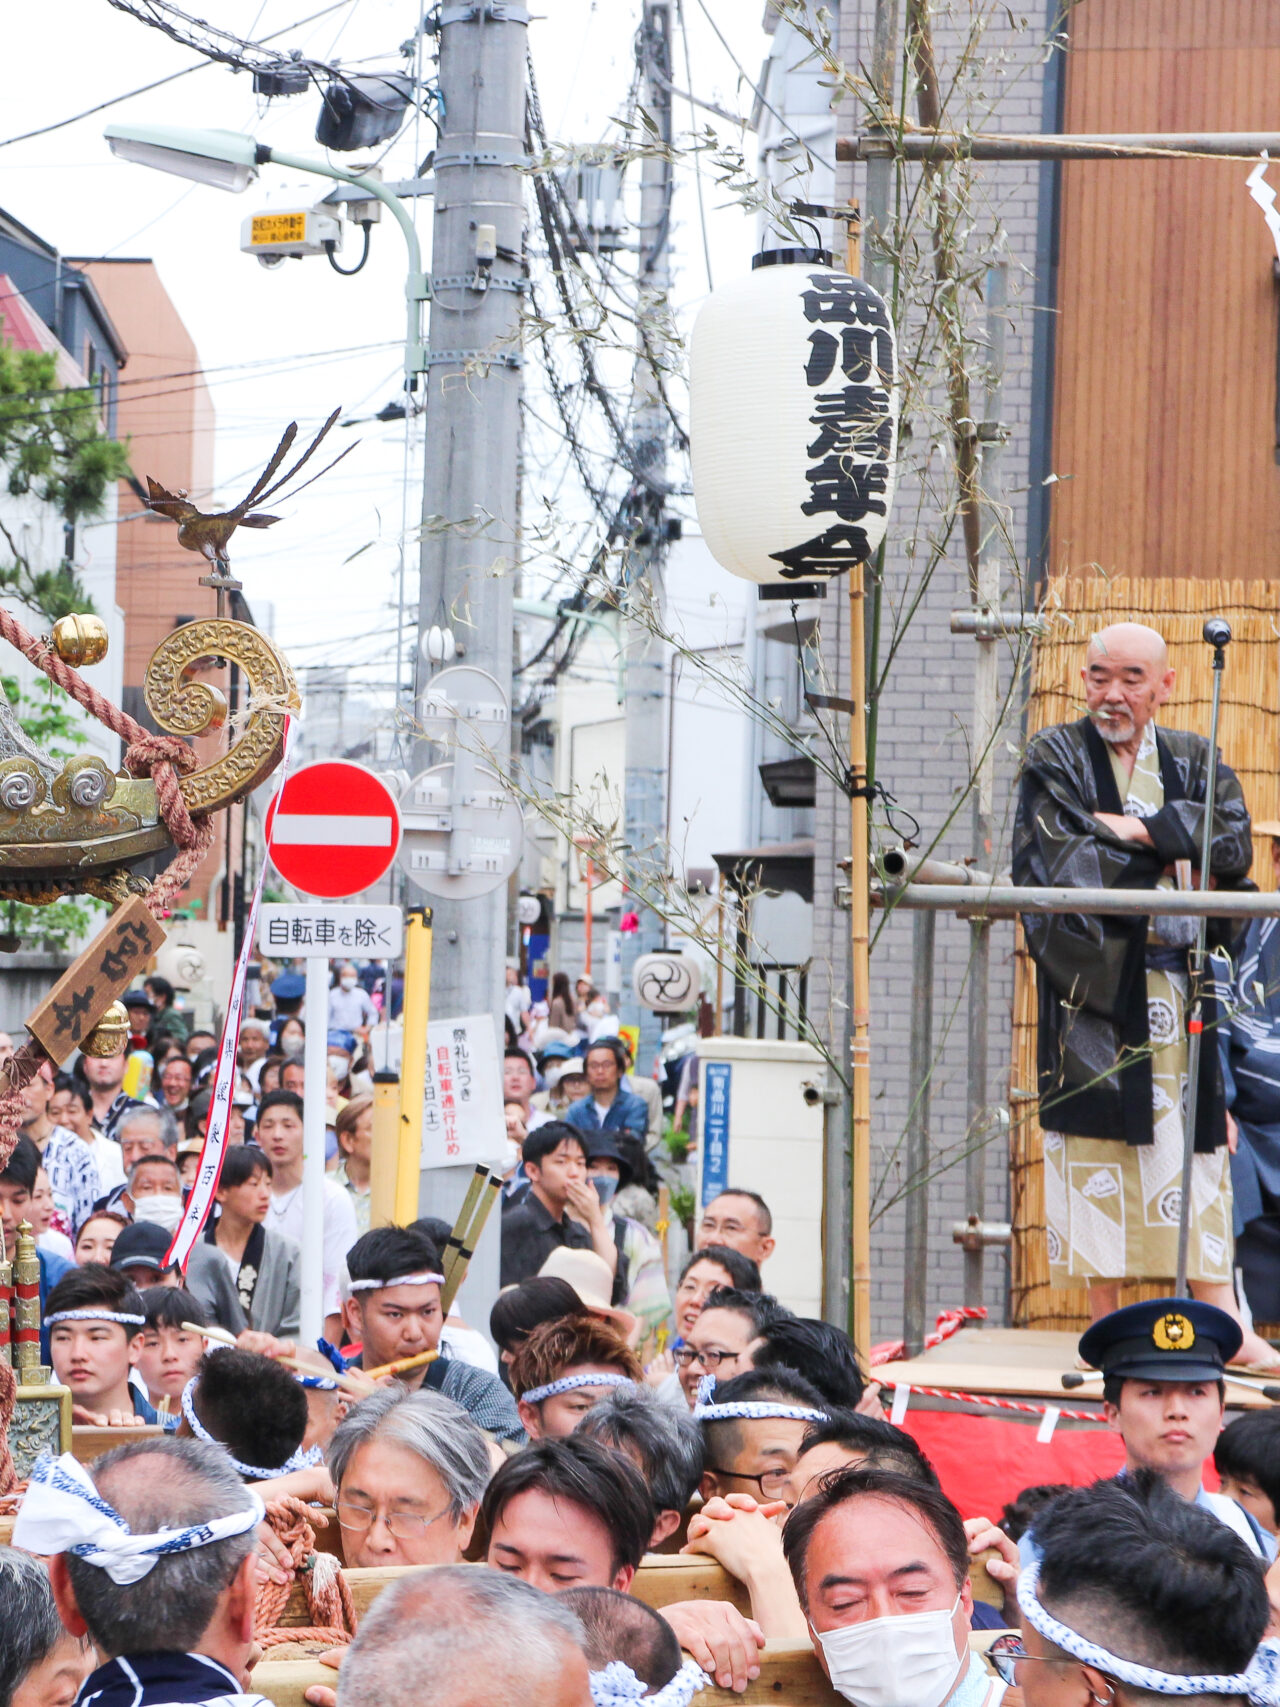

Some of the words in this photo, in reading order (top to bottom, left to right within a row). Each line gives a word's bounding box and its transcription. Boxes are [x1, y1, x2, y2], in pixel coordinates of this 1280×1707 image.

[769, 273, 893, 579] 品川青年会
[269, 917, 392, 947] 自転車を除く
[437, 1046, 460, 1155] 自転車通行止め
[452, 1028, 471, 1102] 祭礼につき
